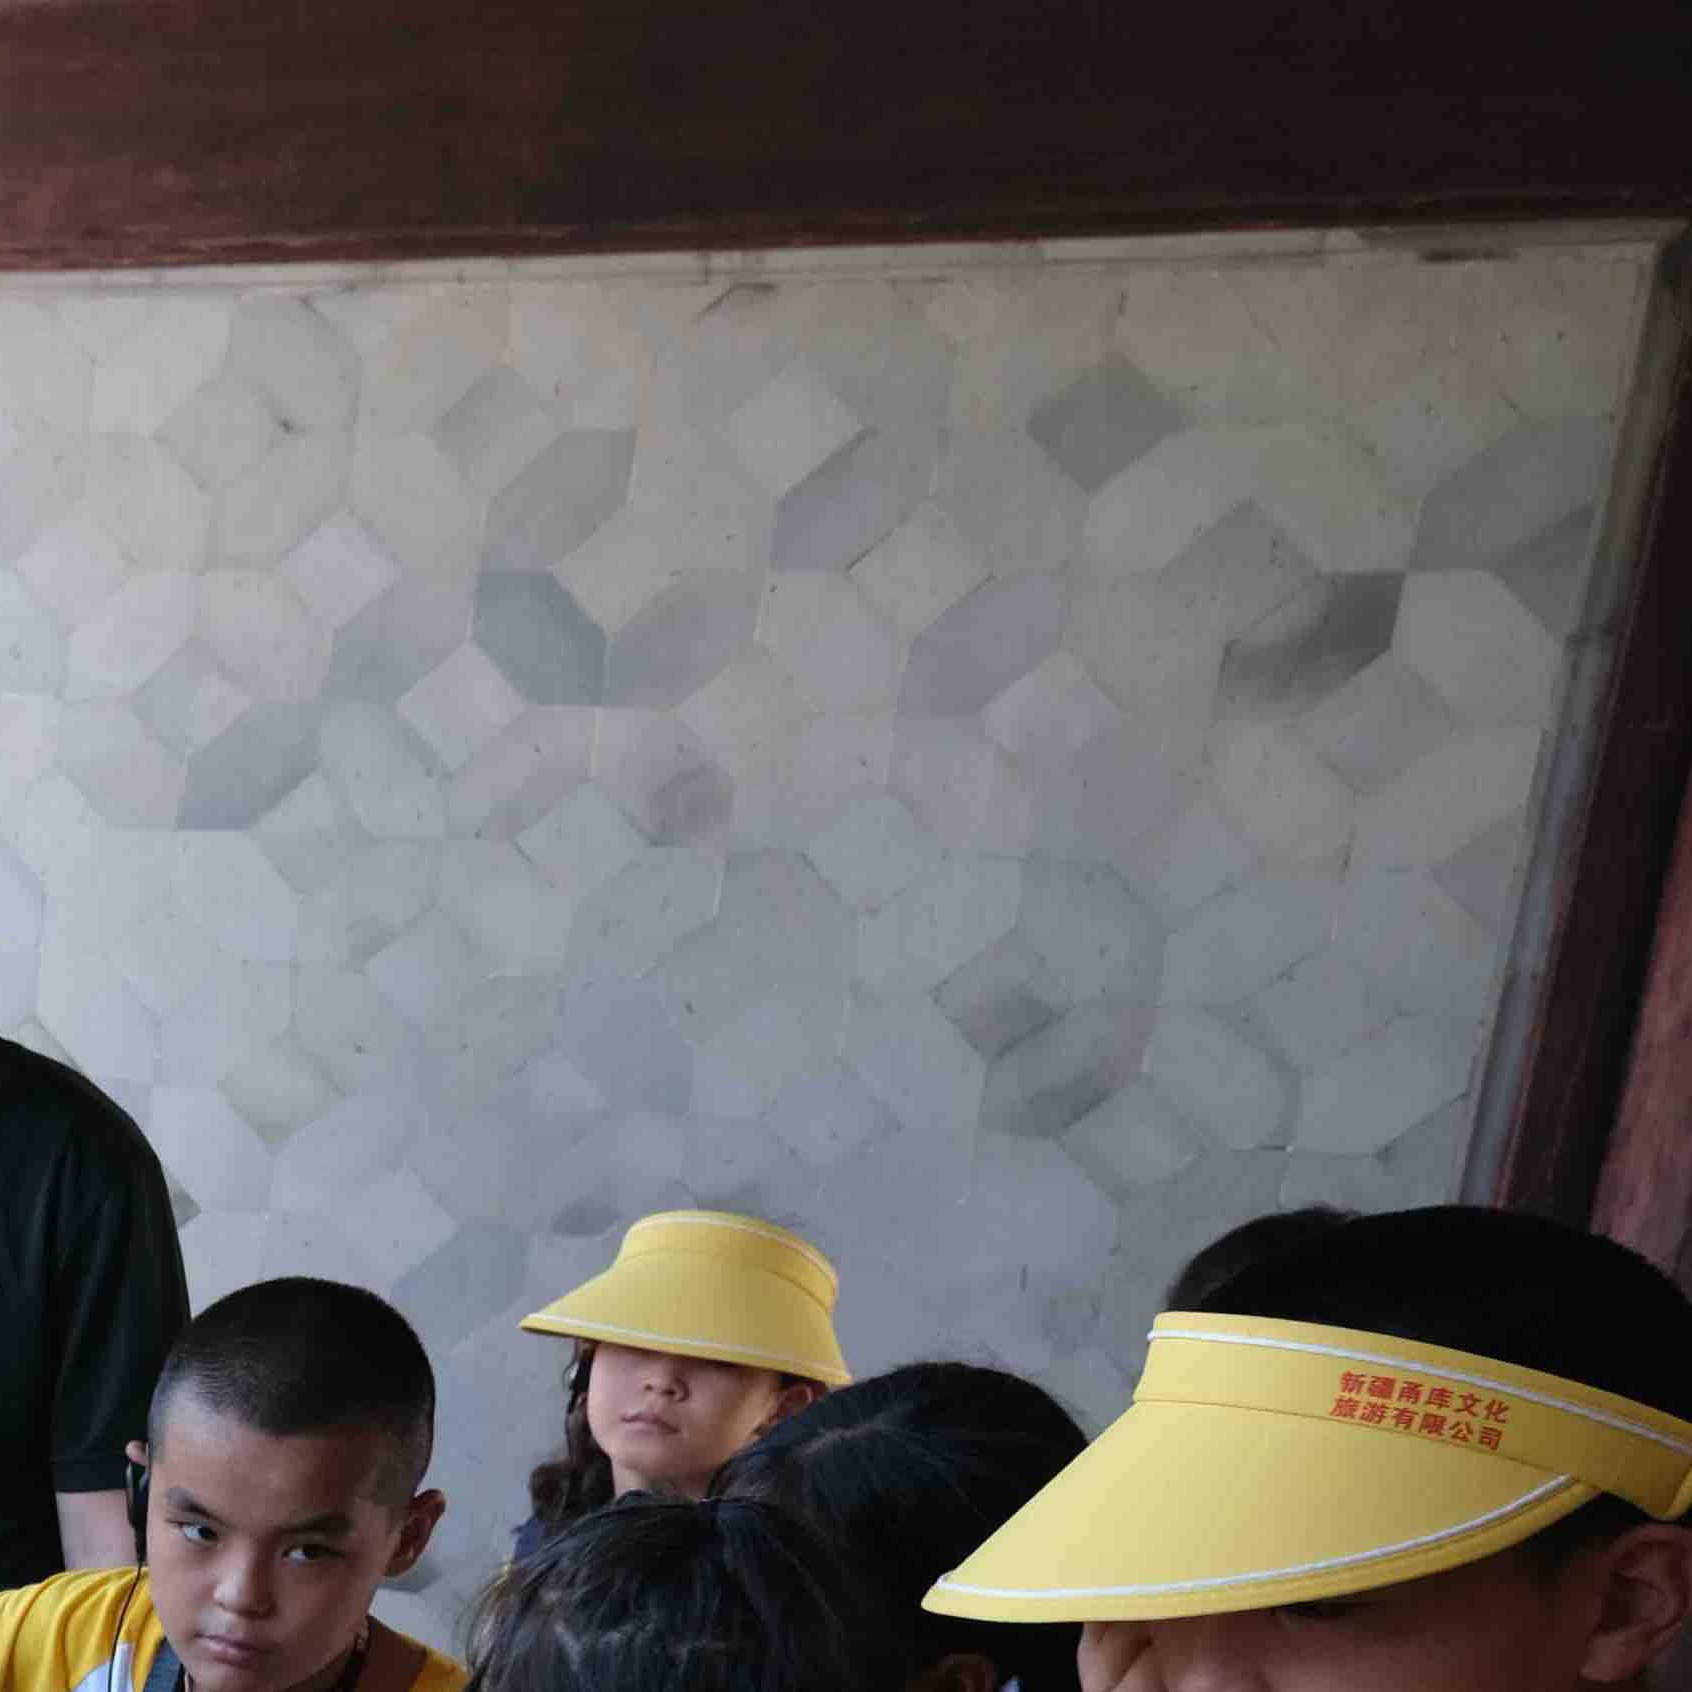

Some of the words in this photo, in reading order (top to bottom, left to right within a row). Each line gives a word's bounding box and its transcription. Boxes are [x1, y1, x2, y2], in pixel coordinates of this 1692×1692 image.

[1341, 1371, 1509, 1423] 新疆甬库文化
[1330, 1398, 1502, 1450] 旅游有限公司
